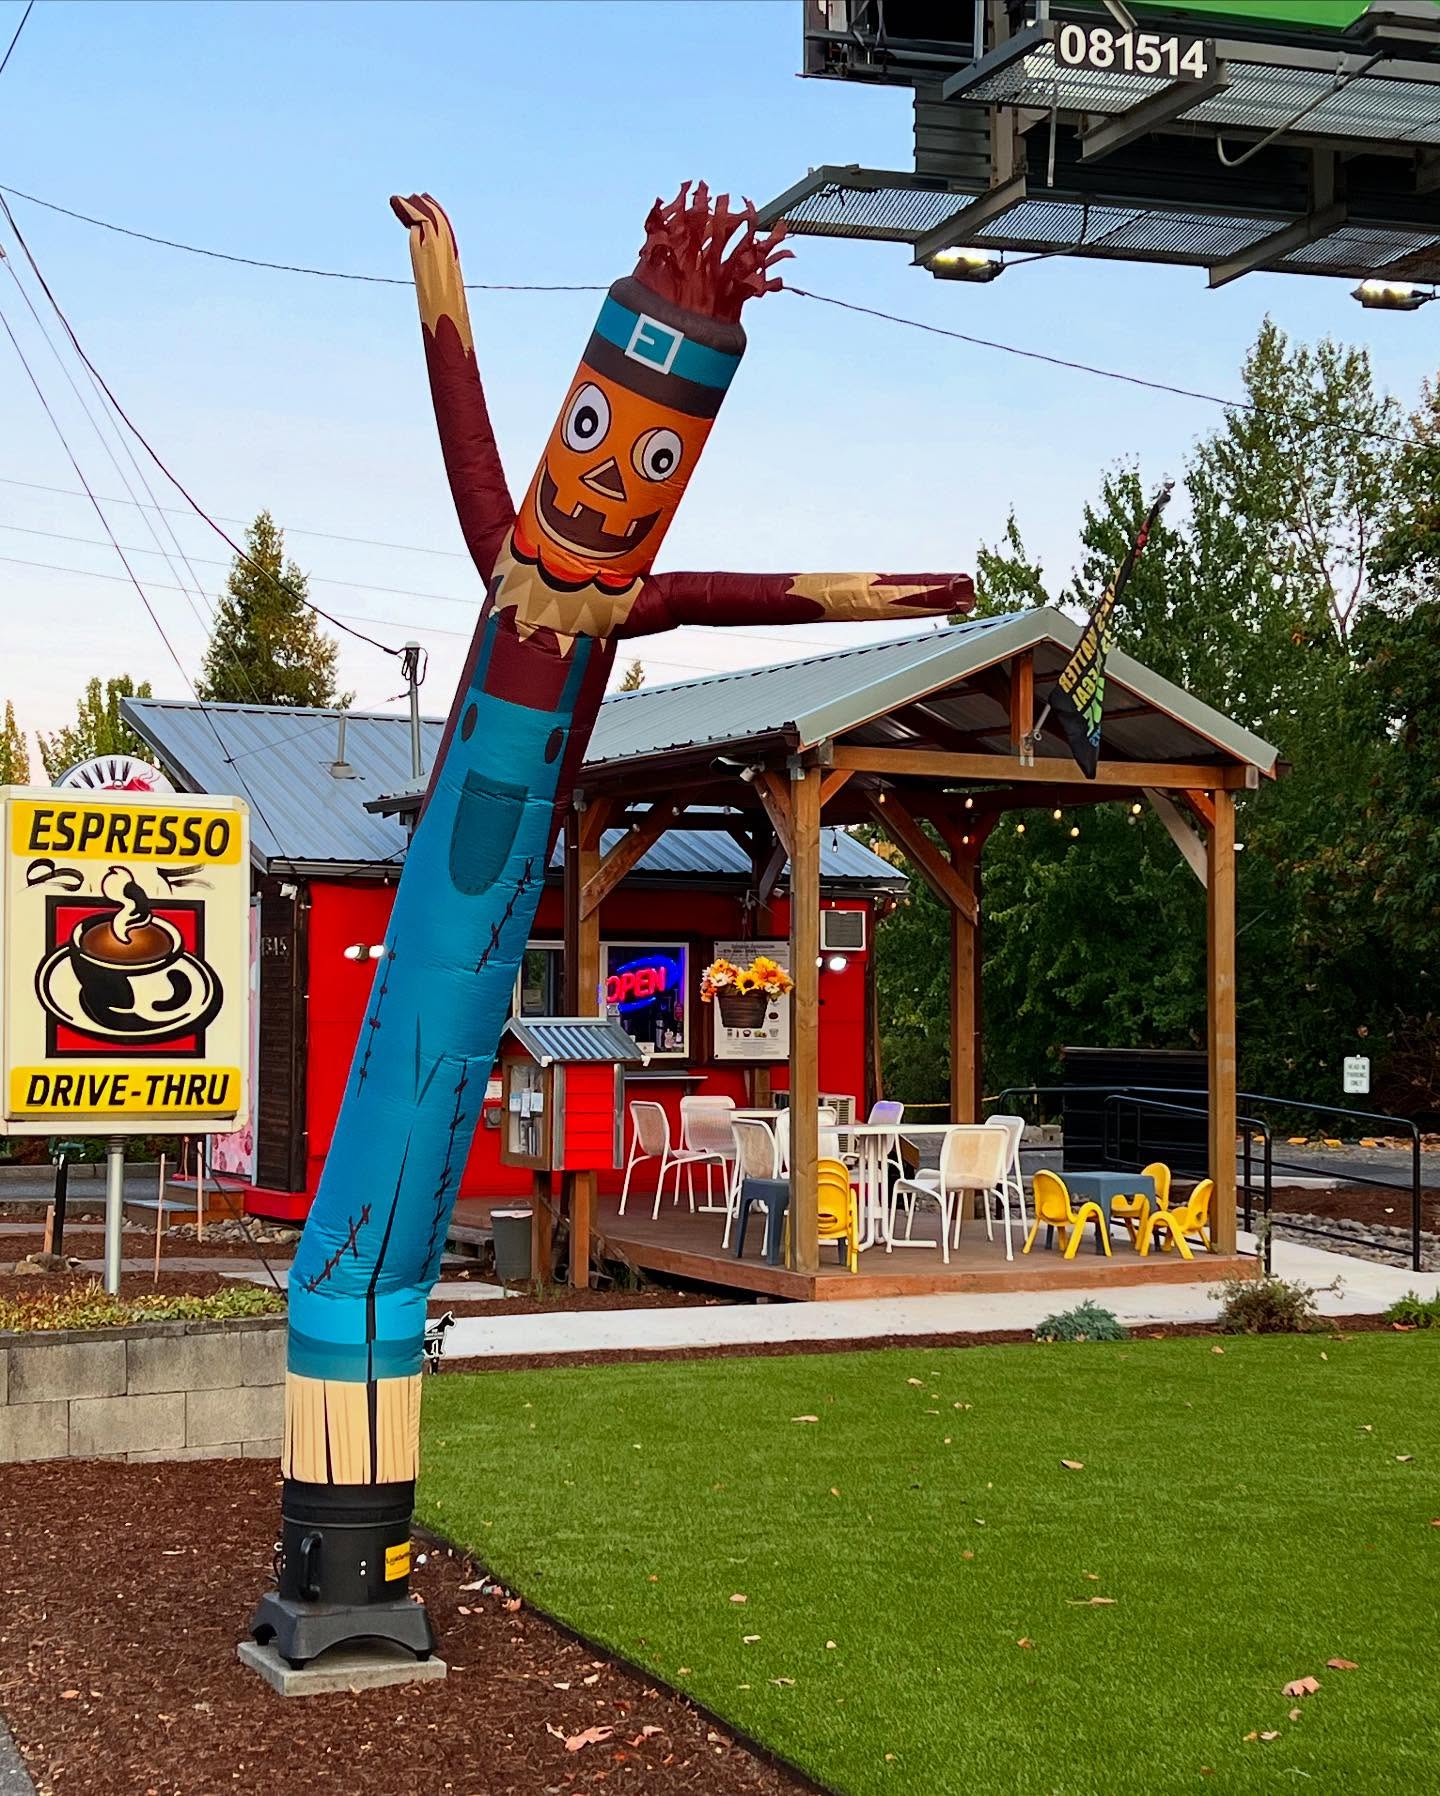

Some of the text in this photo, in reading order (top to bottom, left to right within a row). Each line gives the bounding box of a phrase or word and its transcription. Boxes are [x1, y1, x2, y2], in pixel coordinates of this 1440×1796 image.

[1060, 24, 1208, 79] 081514
[28, 809, 230, 858] ESPRESSO
[606, 966, 667, 1004] OPEN
[26, 1073, 230, 1107] DRIVE-THRU
